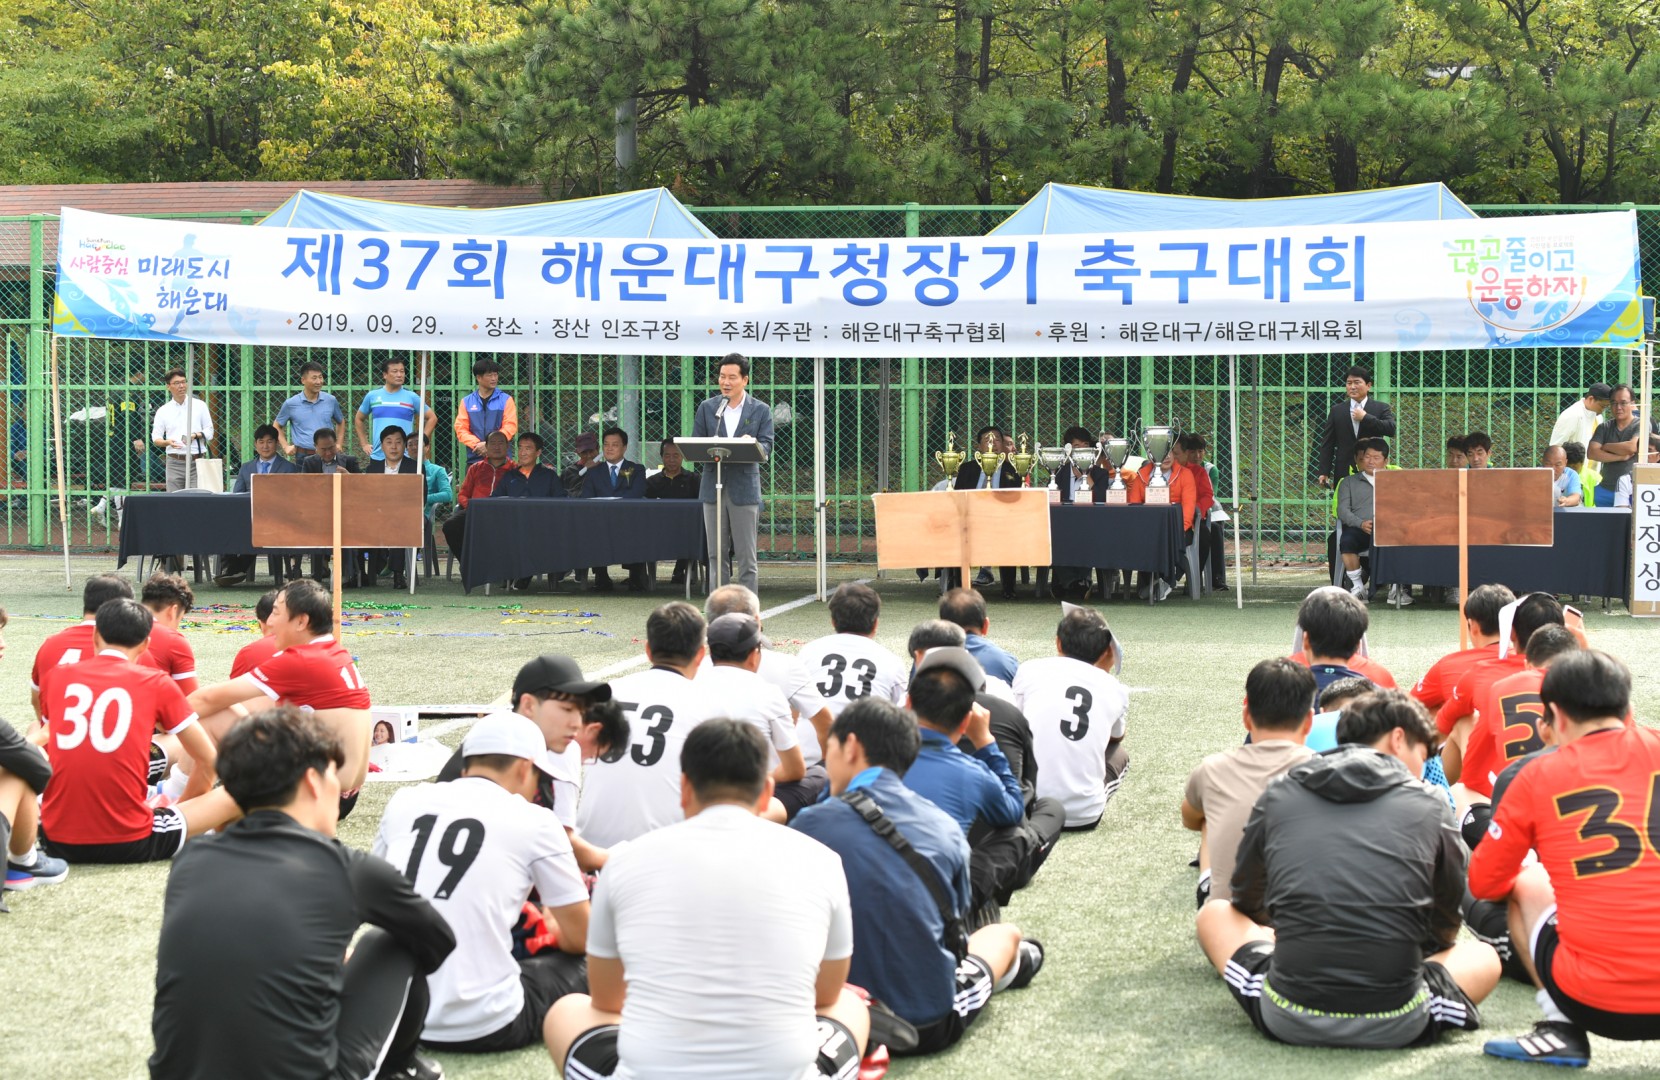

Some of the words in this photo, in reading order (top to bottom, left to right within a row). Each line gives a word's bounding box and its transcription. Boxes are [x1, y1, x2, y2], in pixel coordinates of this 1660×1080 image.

[70, 254, 129, 276] 사람중심
[137, 255, 230, 279] 미래도시
[282, 233, 507, 300] 제37회
[541, 241, 1039, 307] 해운대구청장기
[1074, 235, 1366, 305] 축구대회
[1447, 238, 1501, 275] 끊고
[1506, 237, 1574, 272] 줄이고
[156, 286, 228, 316] 해운대
[1475, 267, 1578, 310] 운동하자
[298, 312, 355, 333] 2019.
[367, 314, 399, 334] 09.
[411, 315, 443, 335] 29.
[485, 317, 523, 337] 장소
[552, 318, 590, 339] 장산
[601, 319, 681, 341] 인조구장
[721, 321, 812, 342] 주최/주관
[841, 322, 1005, 343] 해운대구축구협회
[1048, 322, 1088, 343] 후원
[1119, 319, 1362, 343] 해운대구/해운대구체육회
[816, 653, 877, 702] 33
[56, 682, 133, 753] 30
[1060, 685, 1093, 741] 3
[403, 813, 485, 900] 19
